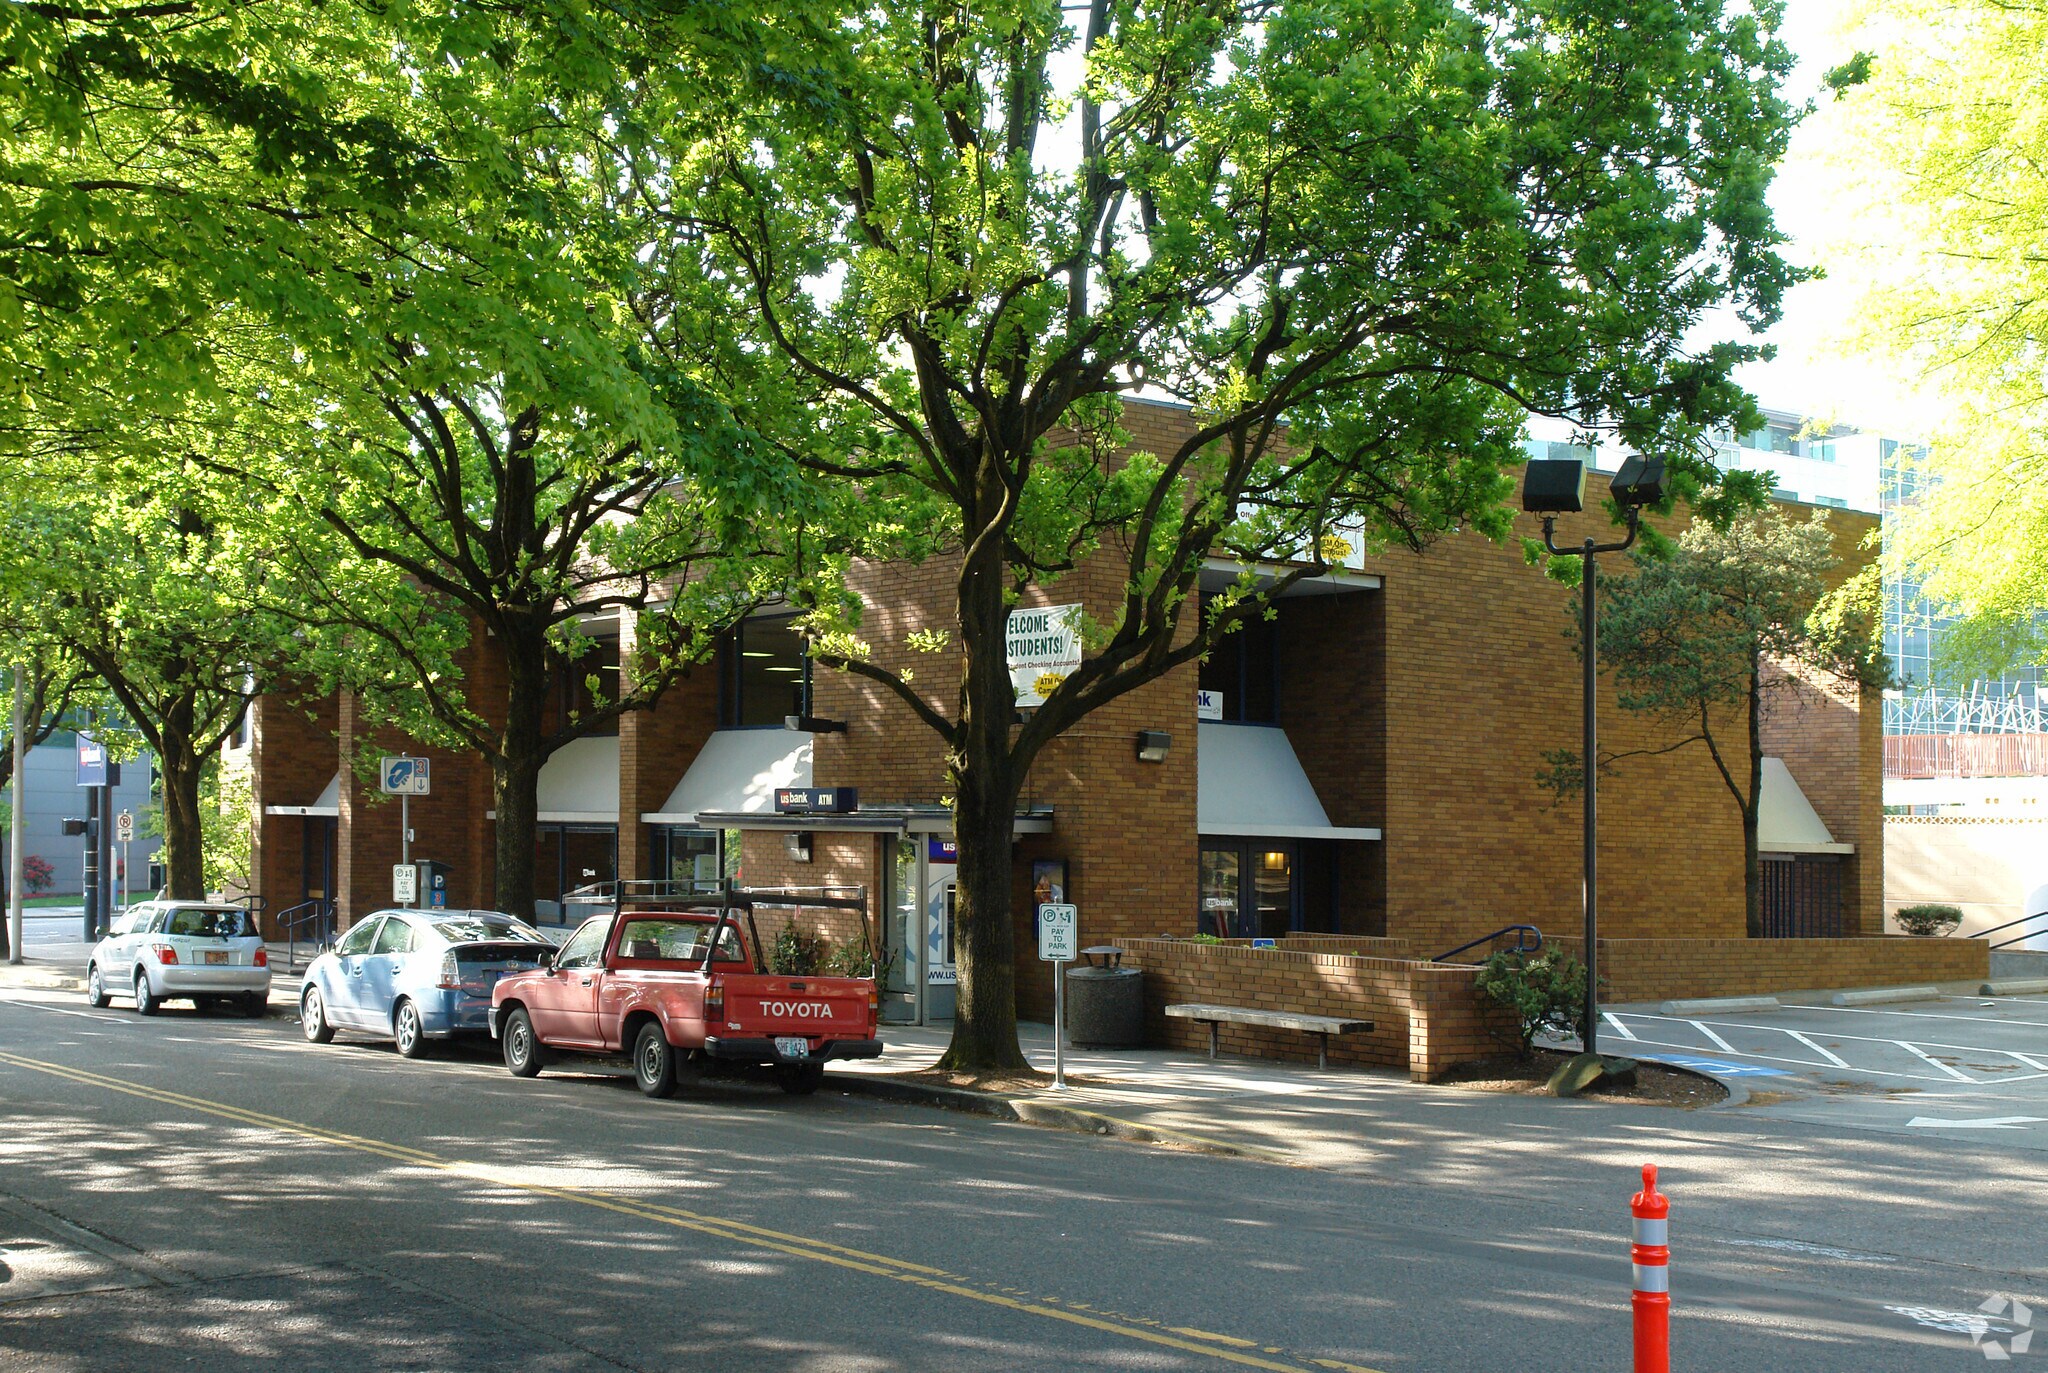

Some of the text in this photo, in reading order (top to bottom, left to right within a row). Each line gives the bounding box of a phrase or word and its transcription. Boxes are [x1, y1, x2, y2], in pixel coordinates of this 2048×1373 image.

[1008, 636, 1063, 657] STUDENTS!
[1028, 660, 1052, 669] Checking
[1053, 658, 1080, 667] Accounts!
[1040, 677, 1053, 685] ATM
[416, 760, 426, 774] 3
[818, 794, 833, 806] ATM
[759, 1001, 833, 1018] TOYOTA
